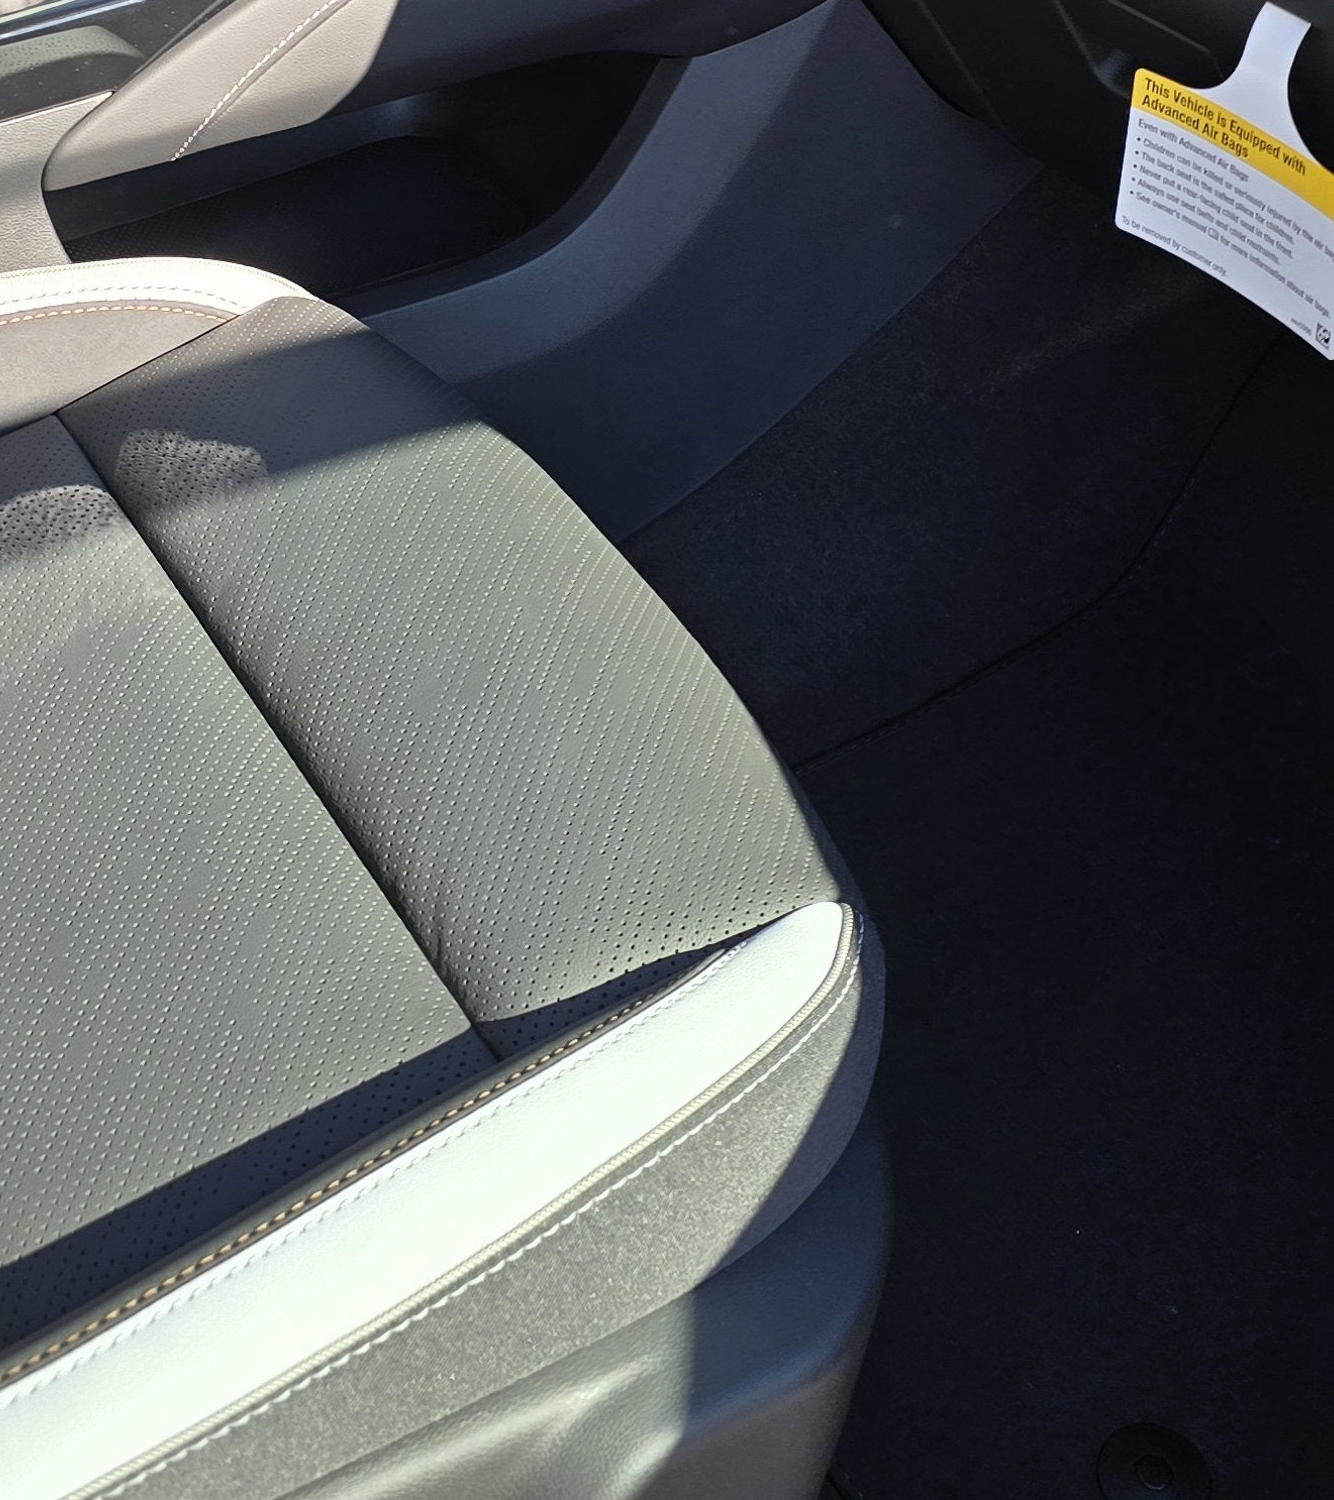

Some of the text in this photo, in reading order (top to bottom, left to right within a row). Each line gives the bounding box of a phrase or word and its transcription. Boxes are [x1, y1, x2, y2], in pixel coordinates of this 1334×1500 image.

[1138, 118, 1158, 134] Even
[1160, 129, 1177, 143] with
[1179, 137, 1217, 164] Advanced
[1218, 158, 1229, 169] Air
[1142, 95, 1248, 157] Advanced Air Bags
[1145, 77, 1169, 99] This
[1174, 90, 1214, 120] Vehicle
[1230, 120, 1280, 159] Equipped
[1283, 153, 1306, 176] with
[1137, 178, 1165, 197] Always
[1215, 219, 1229, 231] and
[1139, 165, 1161, 181] Never
[1163, 177, 1175, 188] put
[1182, 186, 1222, 213] rear-facing
[1222, 208, 1239, 223] child
[1263, 233, 1276, 246] the
[1142, 151, 1155, 164] The
[1157, 159, 1175, 173] back
[1176, 169, 1192, 182] seat
[1192, 176, 1200, 186] is
[1235, 202, 1254, 218] place
[1255, 212, 1266, 225] for
[1143, 138, 1175, 159] Children
[1177, 155, 1191, 167] can
[1192, 161, 1202, 172] be
[1203, 168, 1223, 185] killed
[1224, 181, 1233, 190] or
[1234, 186, 1266, 211] seriously
[1267, 204, 1292, 227] injured
[1292, 221, 1302, 235] by
[1122, 215, 1130, 226] To
[1131, 219, 1141, 230] be
[1141, 226, 1172, 245] removed
[1171, 239, 1182, 251] by
[1135, 191, 1151, 204] See
[1220, 235, 1231, 246] for
